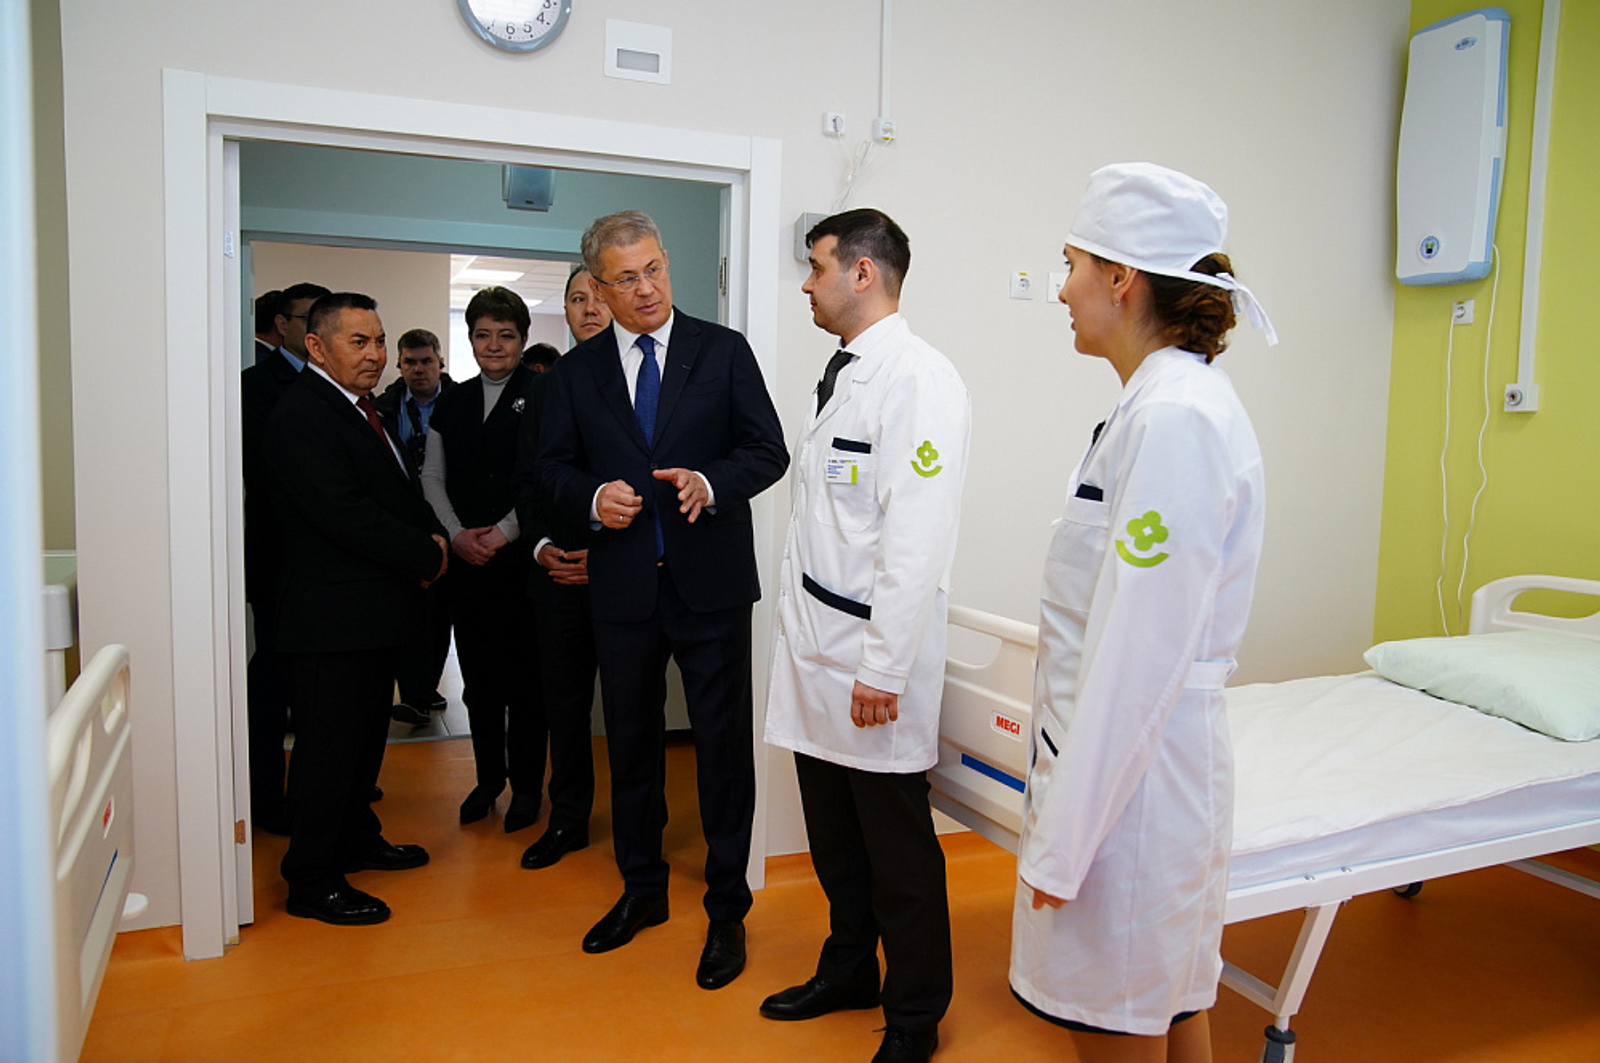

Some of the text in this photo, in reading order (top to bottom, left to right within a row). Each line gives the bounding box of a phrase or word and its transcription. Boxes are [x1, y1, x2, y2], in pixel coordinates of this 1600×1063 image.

[543, 0, 551, 9] 3
[536, 11, 545, 24] 4
[506, 21, 515, 35] 6
[523, 21, 532, 33] 5
